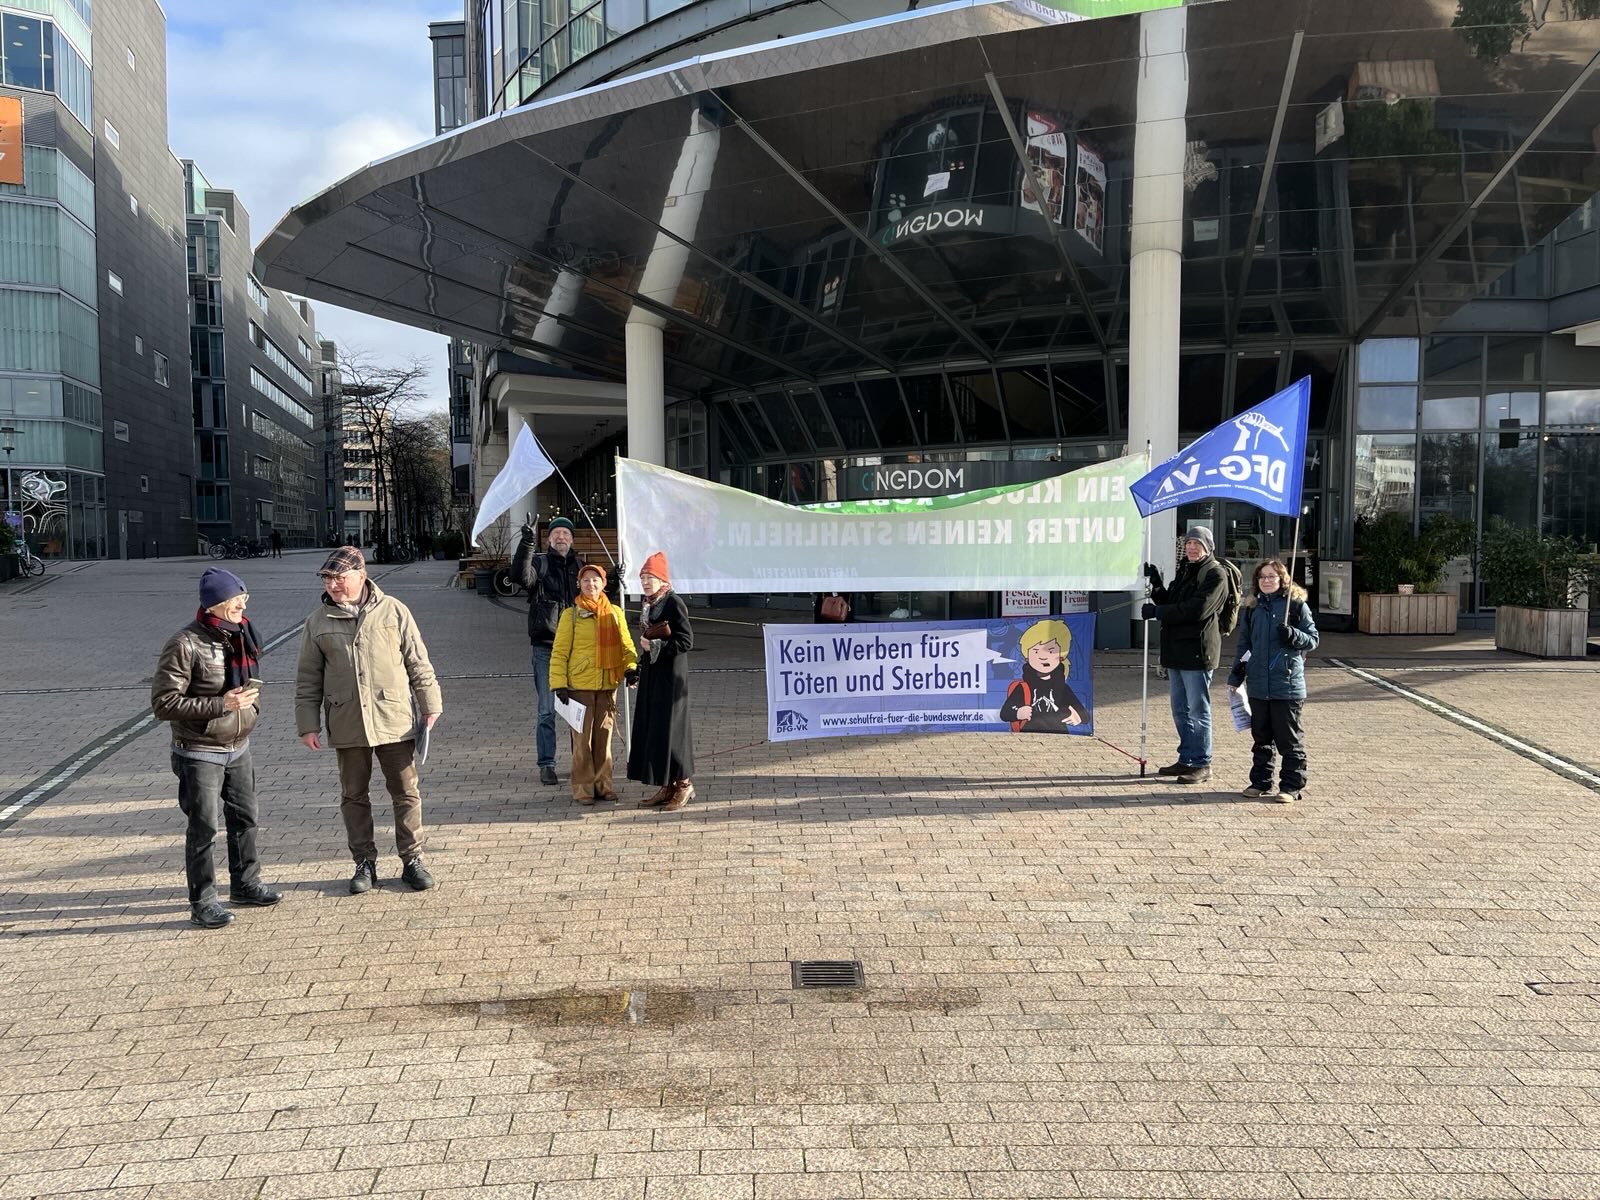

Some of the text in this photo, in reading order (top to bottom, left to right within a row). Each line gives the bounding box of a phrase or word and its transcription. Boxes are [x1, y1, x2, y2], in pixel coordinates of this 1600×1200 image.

[1005, 595, 1048, 605] Freunde
[779, 633, 960, 664] Kein Werben fürs
[780, 663, 980, 696] Töten und Sterben!
[822, 712, 984, 727] www.schulfrei-fuer-die-bundeswehr.de
[776, 723, 808, 734] DFG-VK
